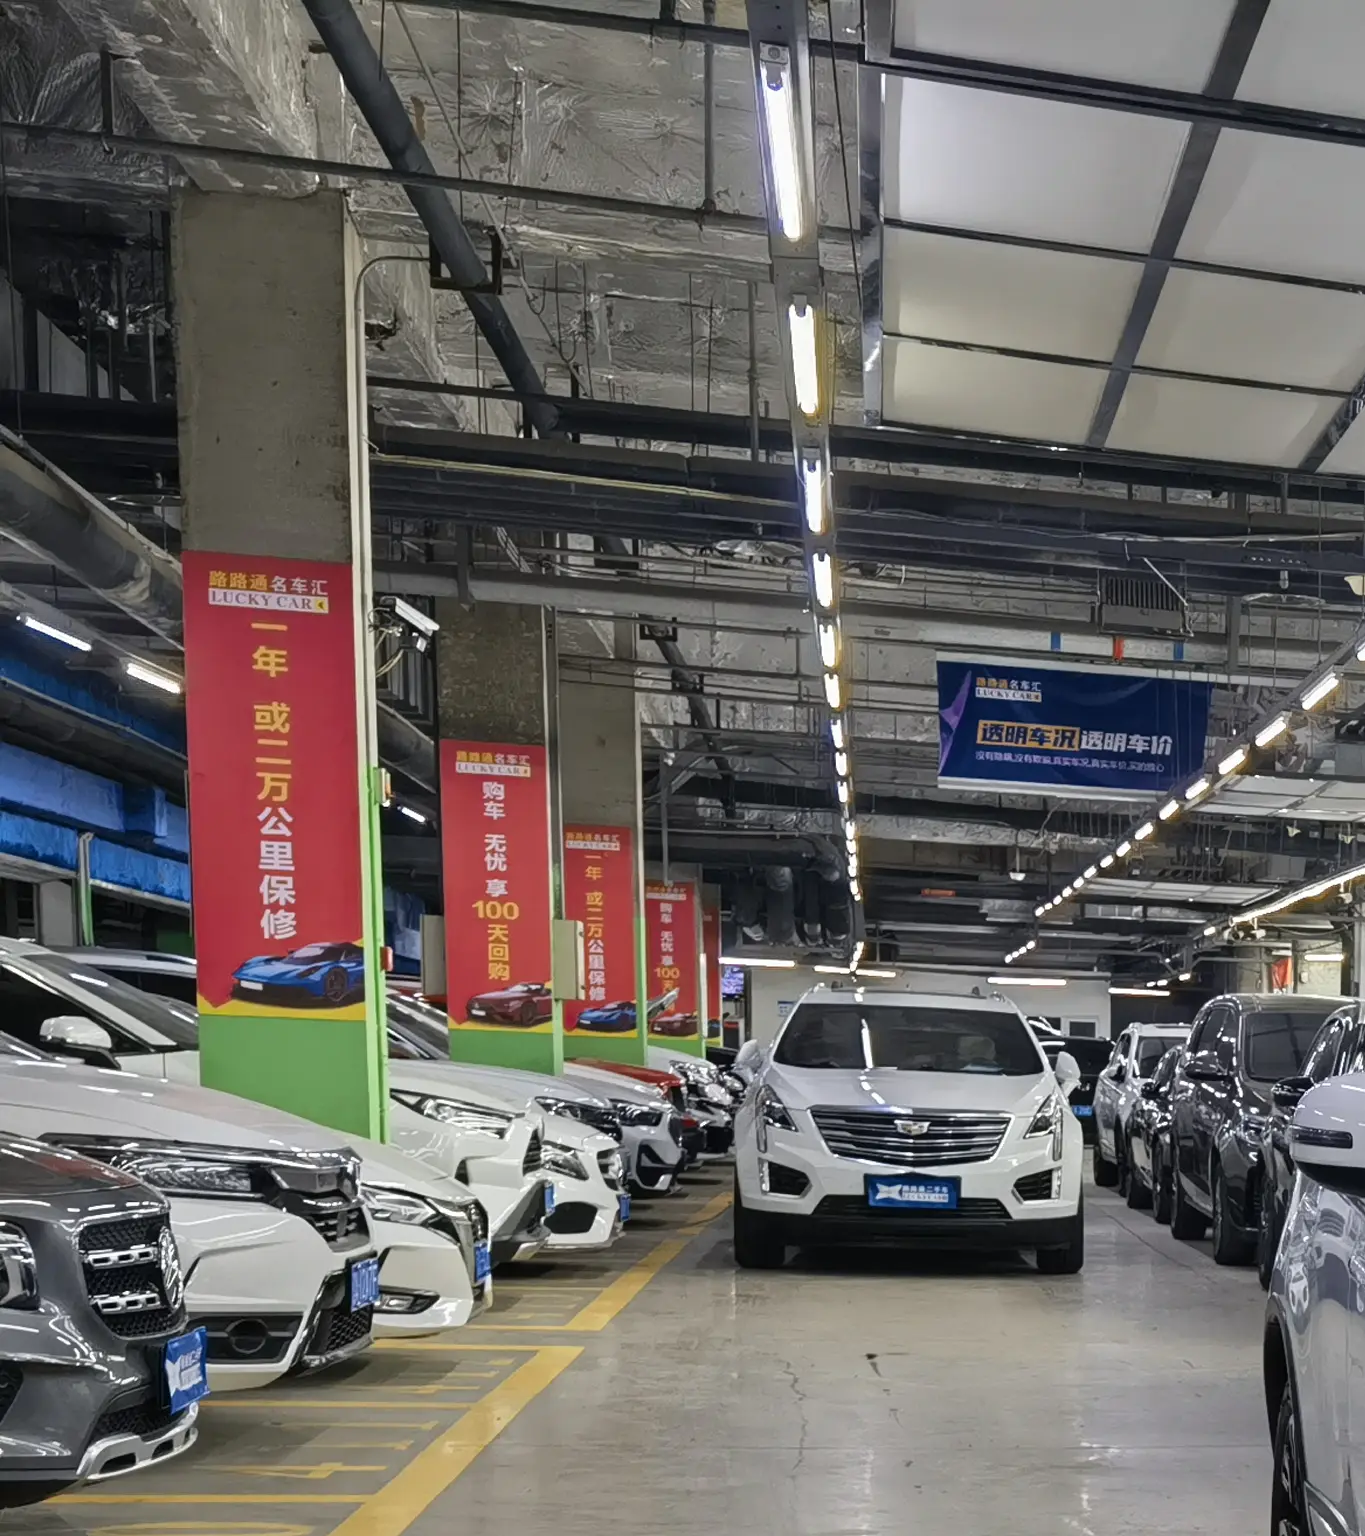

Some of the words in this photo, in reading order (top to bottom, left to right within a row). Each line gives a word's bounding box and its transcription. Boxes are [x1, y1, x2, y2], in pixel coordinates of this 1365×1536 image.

[209, 570, 328, 595] 路路通名车汇
[211, 590, 274, 608] LUCKY
[276, 596, 313, 611] CAR
[253, 701, 298, 940] 或二万公里保修
